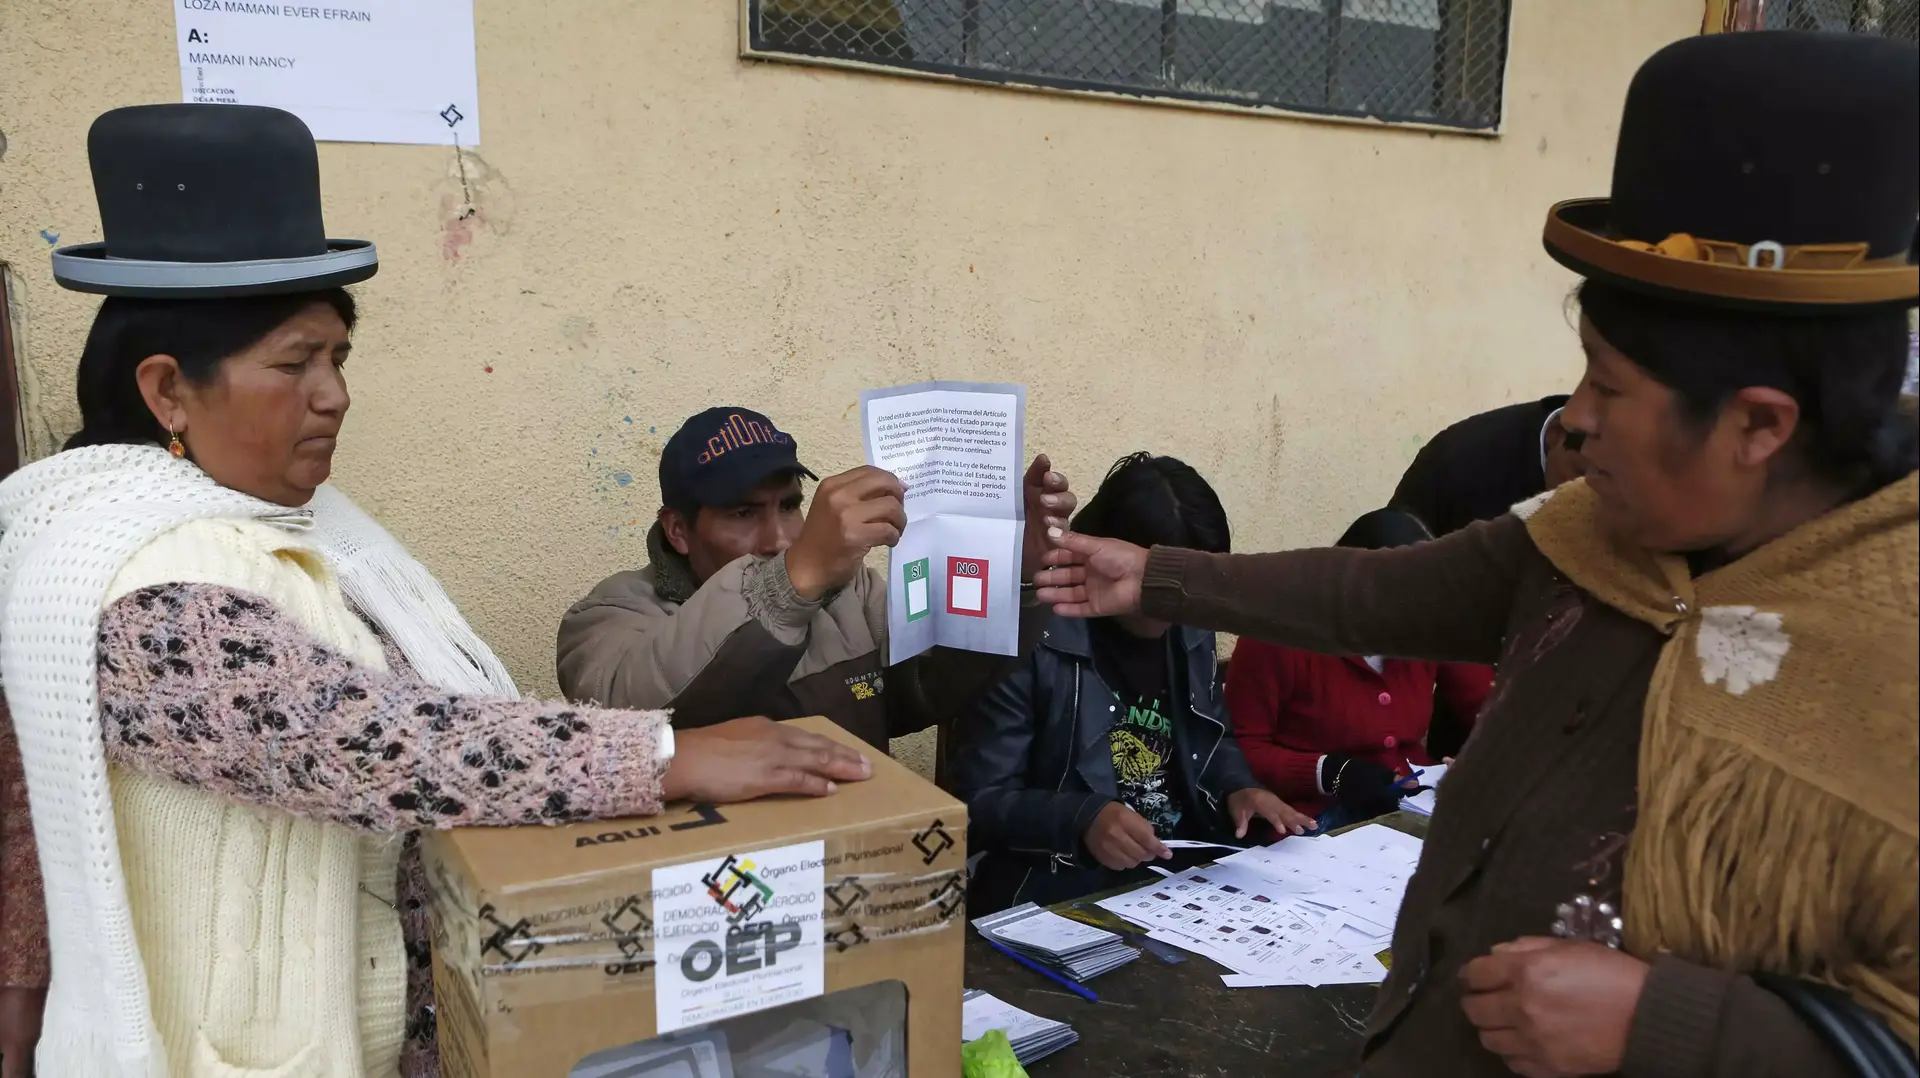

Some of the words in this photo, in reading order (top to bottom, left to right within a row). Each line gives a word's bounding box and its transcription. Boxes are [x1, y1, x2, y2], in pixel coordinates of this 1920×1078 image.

[225, 2, 279, 16] MAMANI
[284, 8, 319, 19] EVER
[324, 9, 371, 22] EFRAIN
[188, 29, 209, 43] A:
[189, 52, 245, 66] MAMANI
[250, 56, 296, 68] NANCY
[912, 408, 932, 416] acuerdo
[948, 408, 972, 416] reforma
[960, 418, 980, 426] Estado
[995, 421, 1007, 429] que
[950, 426, 955, 434] la
[957, 427, 1000, 437] Vicepresidenta
[973, 438, 1001, 446] reelectas
[905, 449, 915, 458] por
[942, 444, 964, 453] manera
[964, 447, 992, 455] continua?
[953, 460, 959, 468] la
[960, 461, 970, 470] Ley
[979, 463, 1007, 472] Reforma
[975, 472, 998, 481] Estado,
[969, 491, 1002, 500] 2020-2025.
[956, 562, 979, 575] NO
[575, 826, 661, 848] AQUI
[760, 864, 798, 882] Órgano
[800, 854, 842, 871] Electoral
[844, 843, 904, 864] Plurinacional
[782, 912, 818, 926] Órgano
[681, 922, 804, 982] OEP
